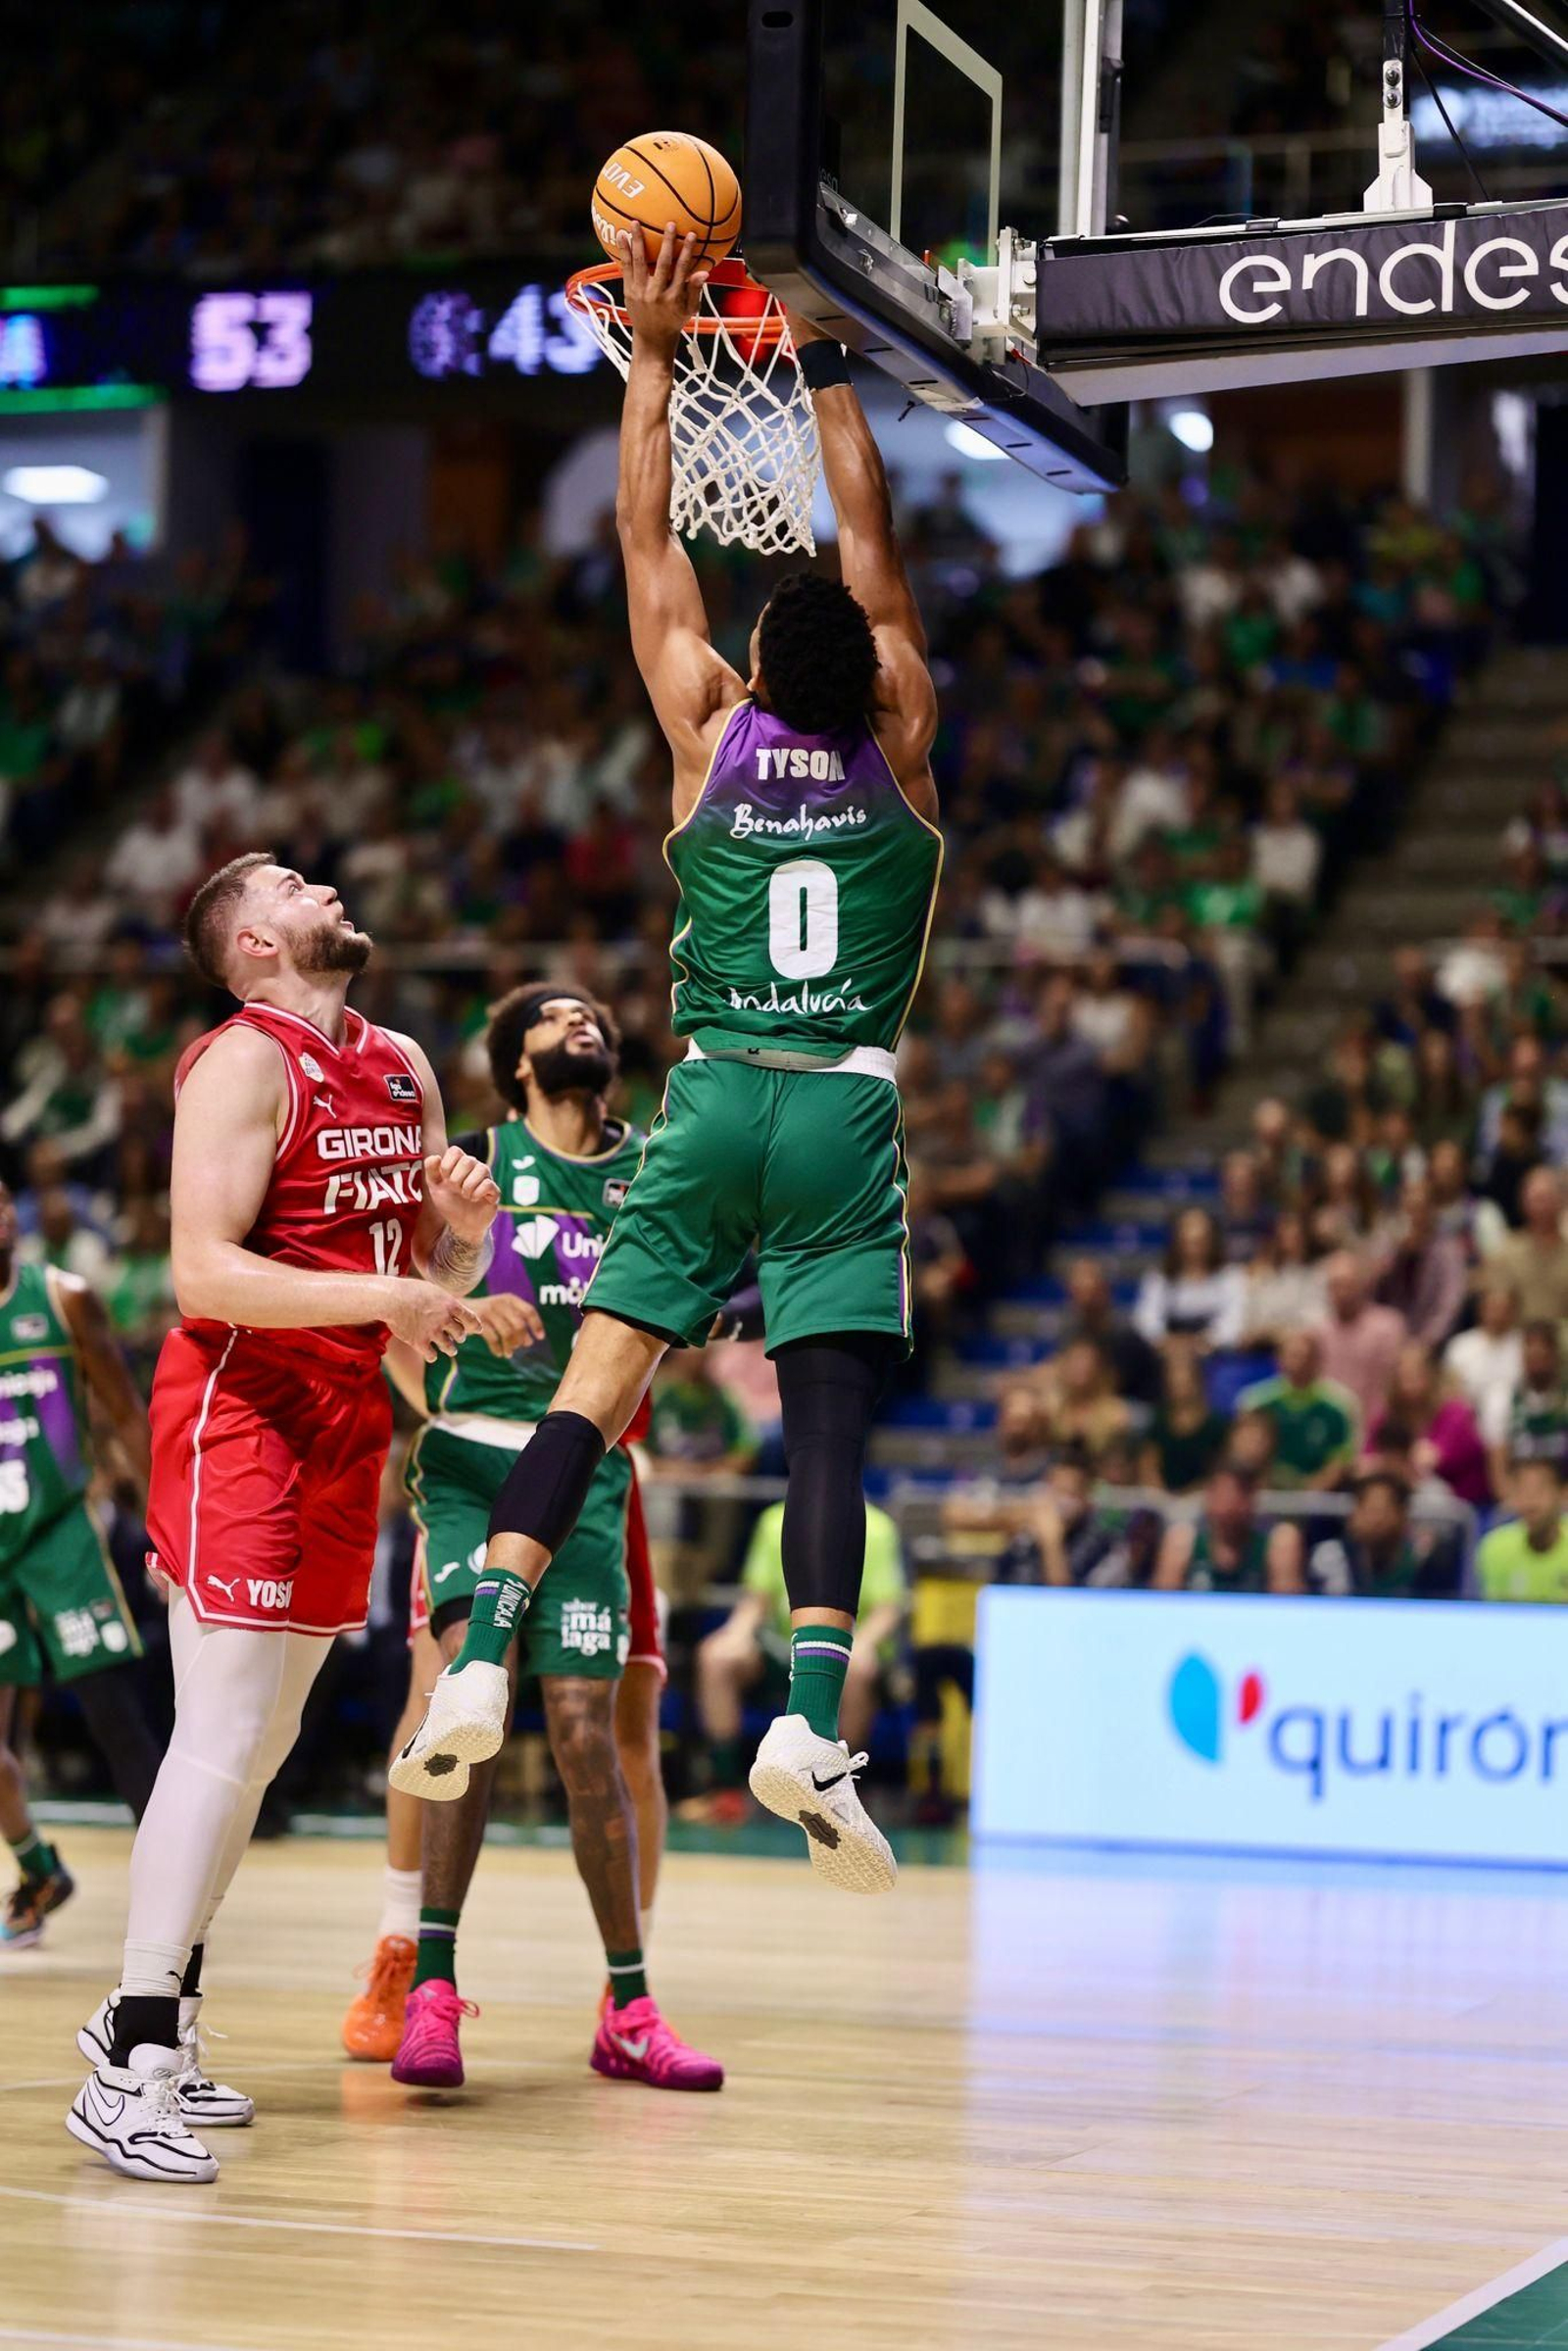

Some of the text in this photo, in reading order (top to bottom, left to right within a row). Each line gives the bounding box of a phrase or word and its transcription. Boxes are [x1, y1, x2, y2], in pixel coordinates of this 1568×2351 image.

[190, 292, 313, 391] 53
[756, 748, 846, 782] TYSON
[769, 859, 838, 980] 0
[368, 1218, 403, 1276] 12
